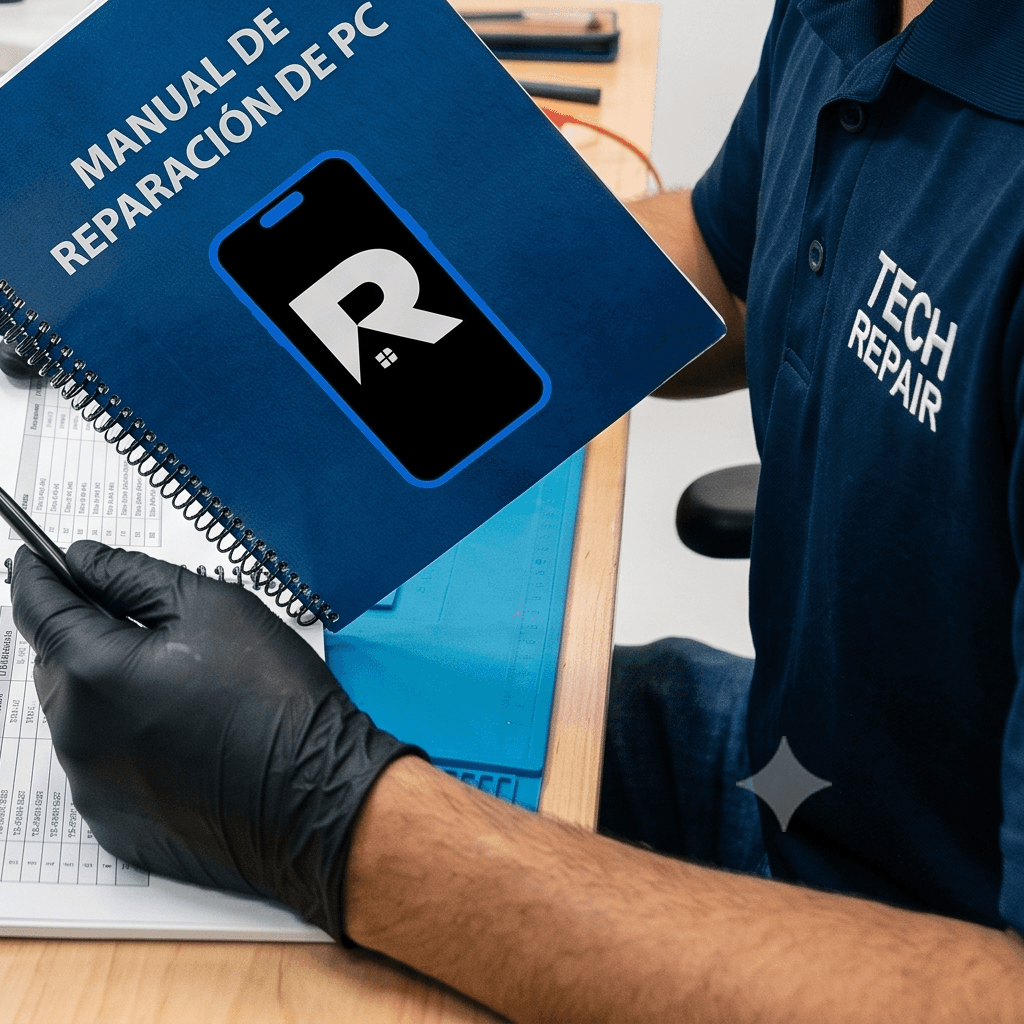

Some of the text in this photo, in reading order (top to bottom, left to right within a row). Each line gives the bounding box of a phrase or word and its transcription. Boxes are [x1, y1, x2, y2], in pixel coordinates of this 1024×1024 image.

[49, 1, 390, 276] REPARACIÓN DE PC
[70, 7, 290, 190] MANUAL DE
[288, 248, 464, 386] R
[847, 308, 943, 433] REPAIR
[866, 249, 958, 382] TECH
